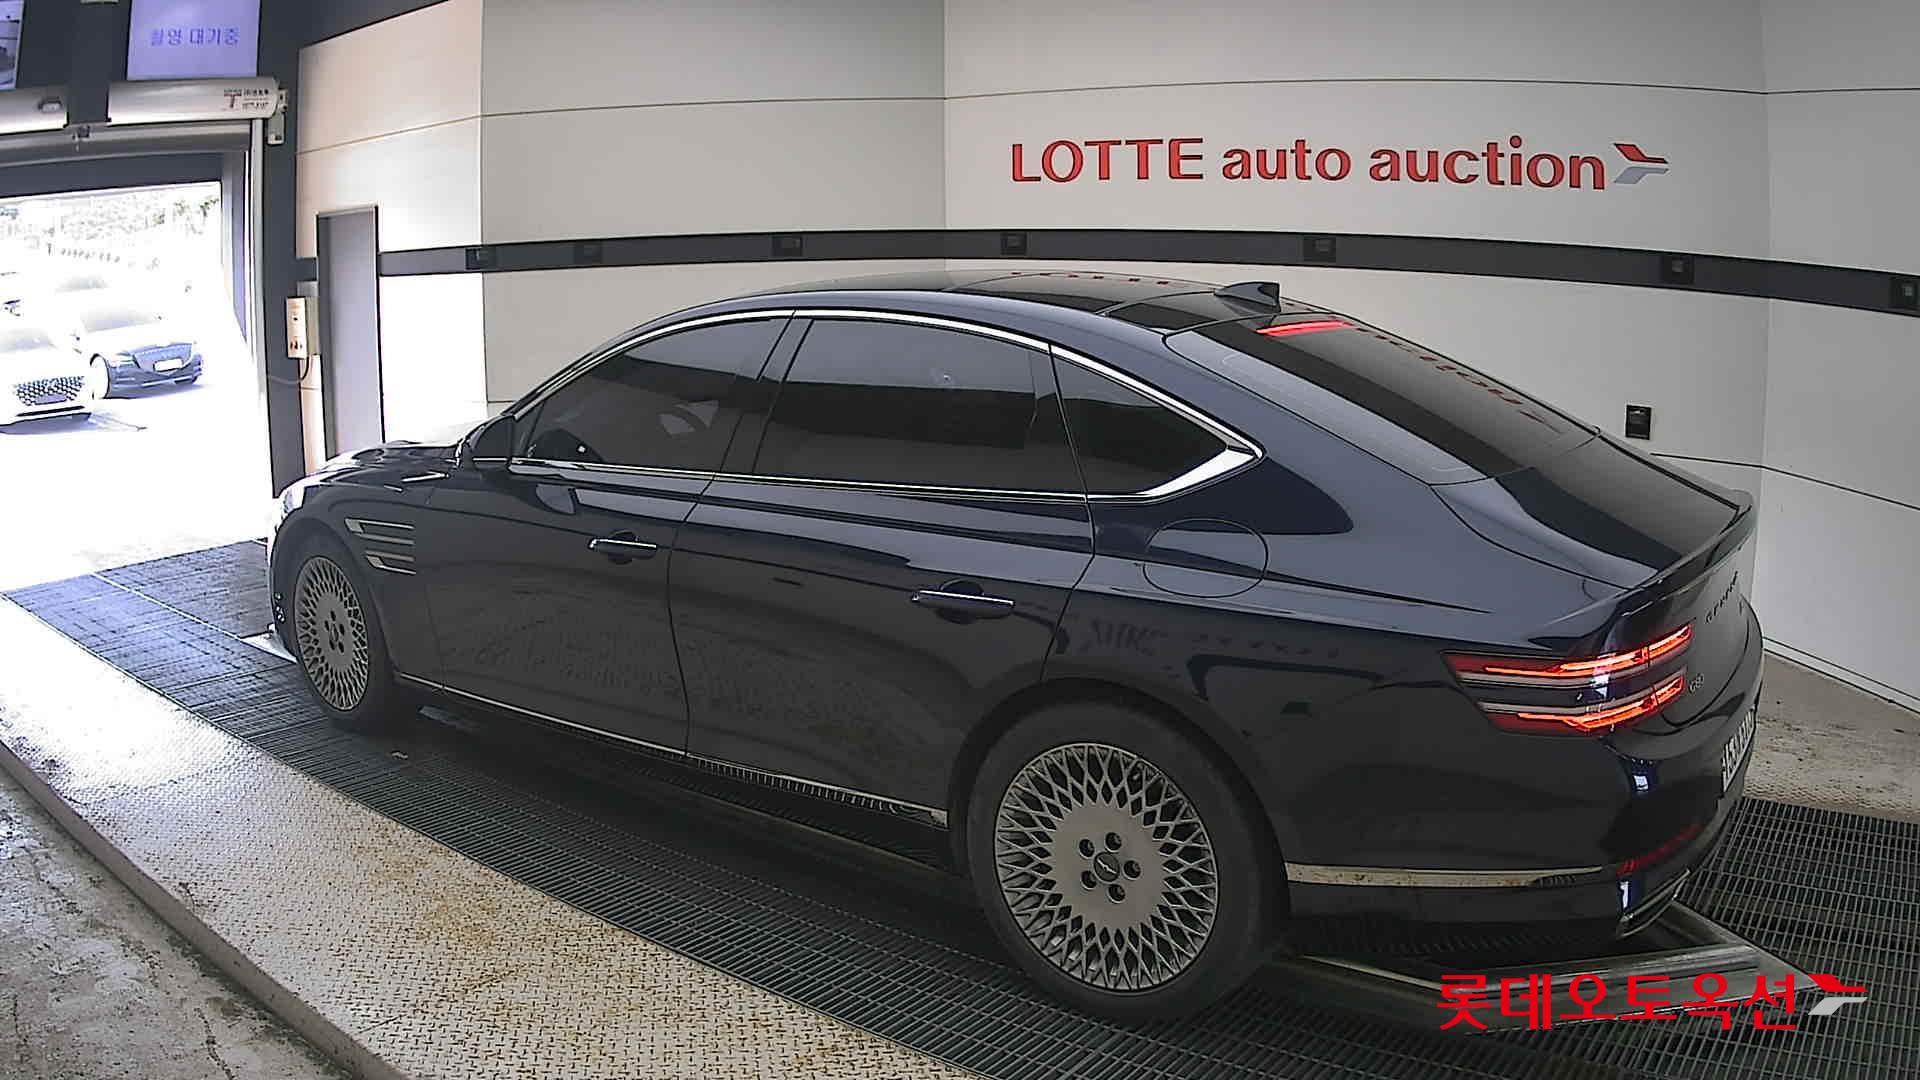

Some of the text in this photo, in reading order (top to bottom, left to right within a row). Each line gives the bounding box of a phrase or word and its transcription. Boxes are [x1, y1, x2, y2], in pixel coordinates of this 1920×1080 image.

[190, 28, 239, 46] 대기중
[1012, 136, 1605, 190] LOTTE auto auction
